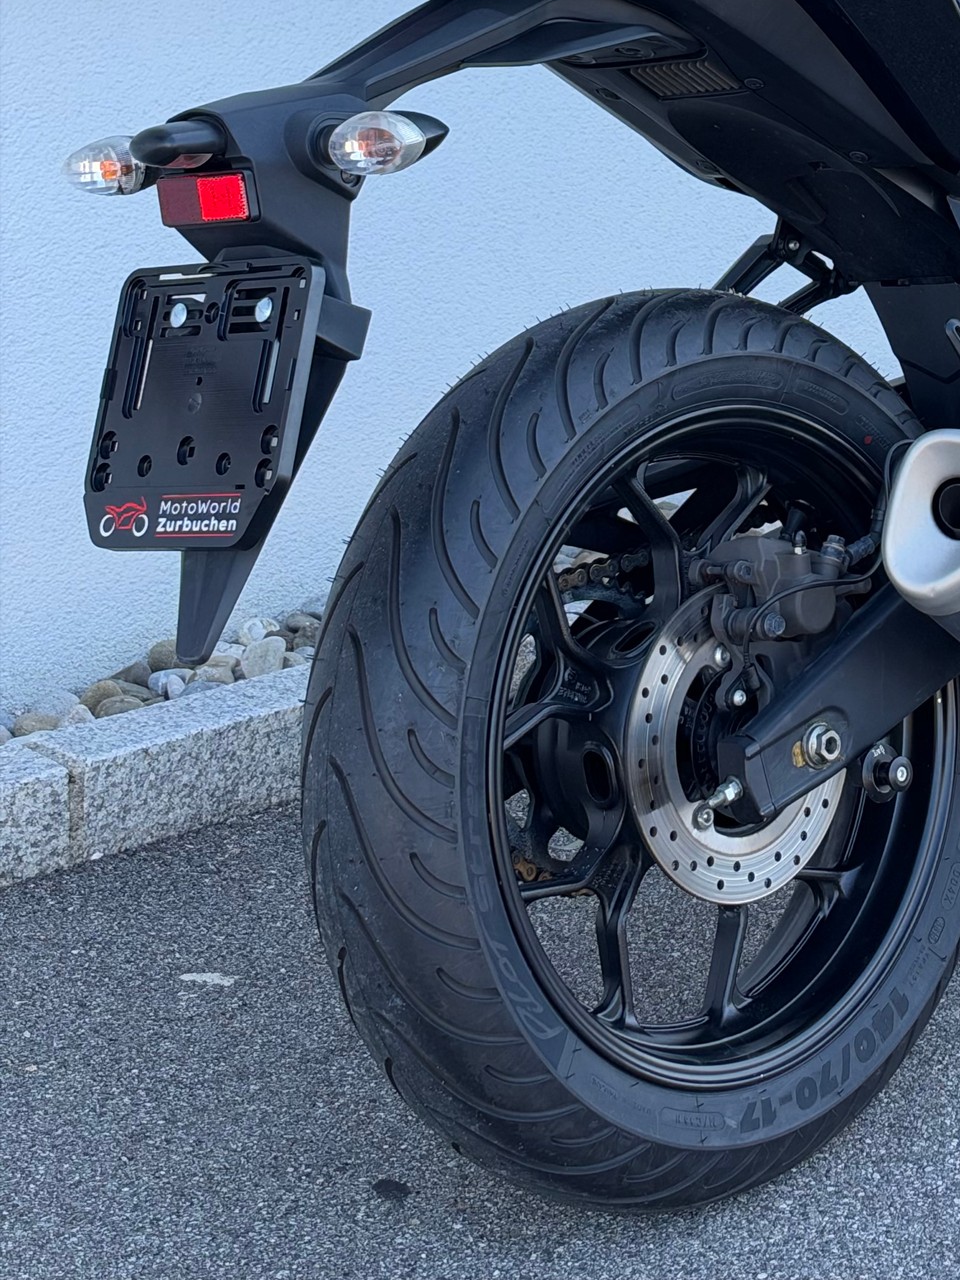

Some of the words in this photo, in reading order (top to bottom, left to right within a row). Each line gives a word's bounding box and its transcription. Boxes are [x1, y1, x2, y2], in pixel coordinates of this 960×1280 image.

[159, 498, 241, 515] MotoWorld
[155, 516, 237, 532] Zurbuchen
[740, 986, 910, 1134] 140/70-17
